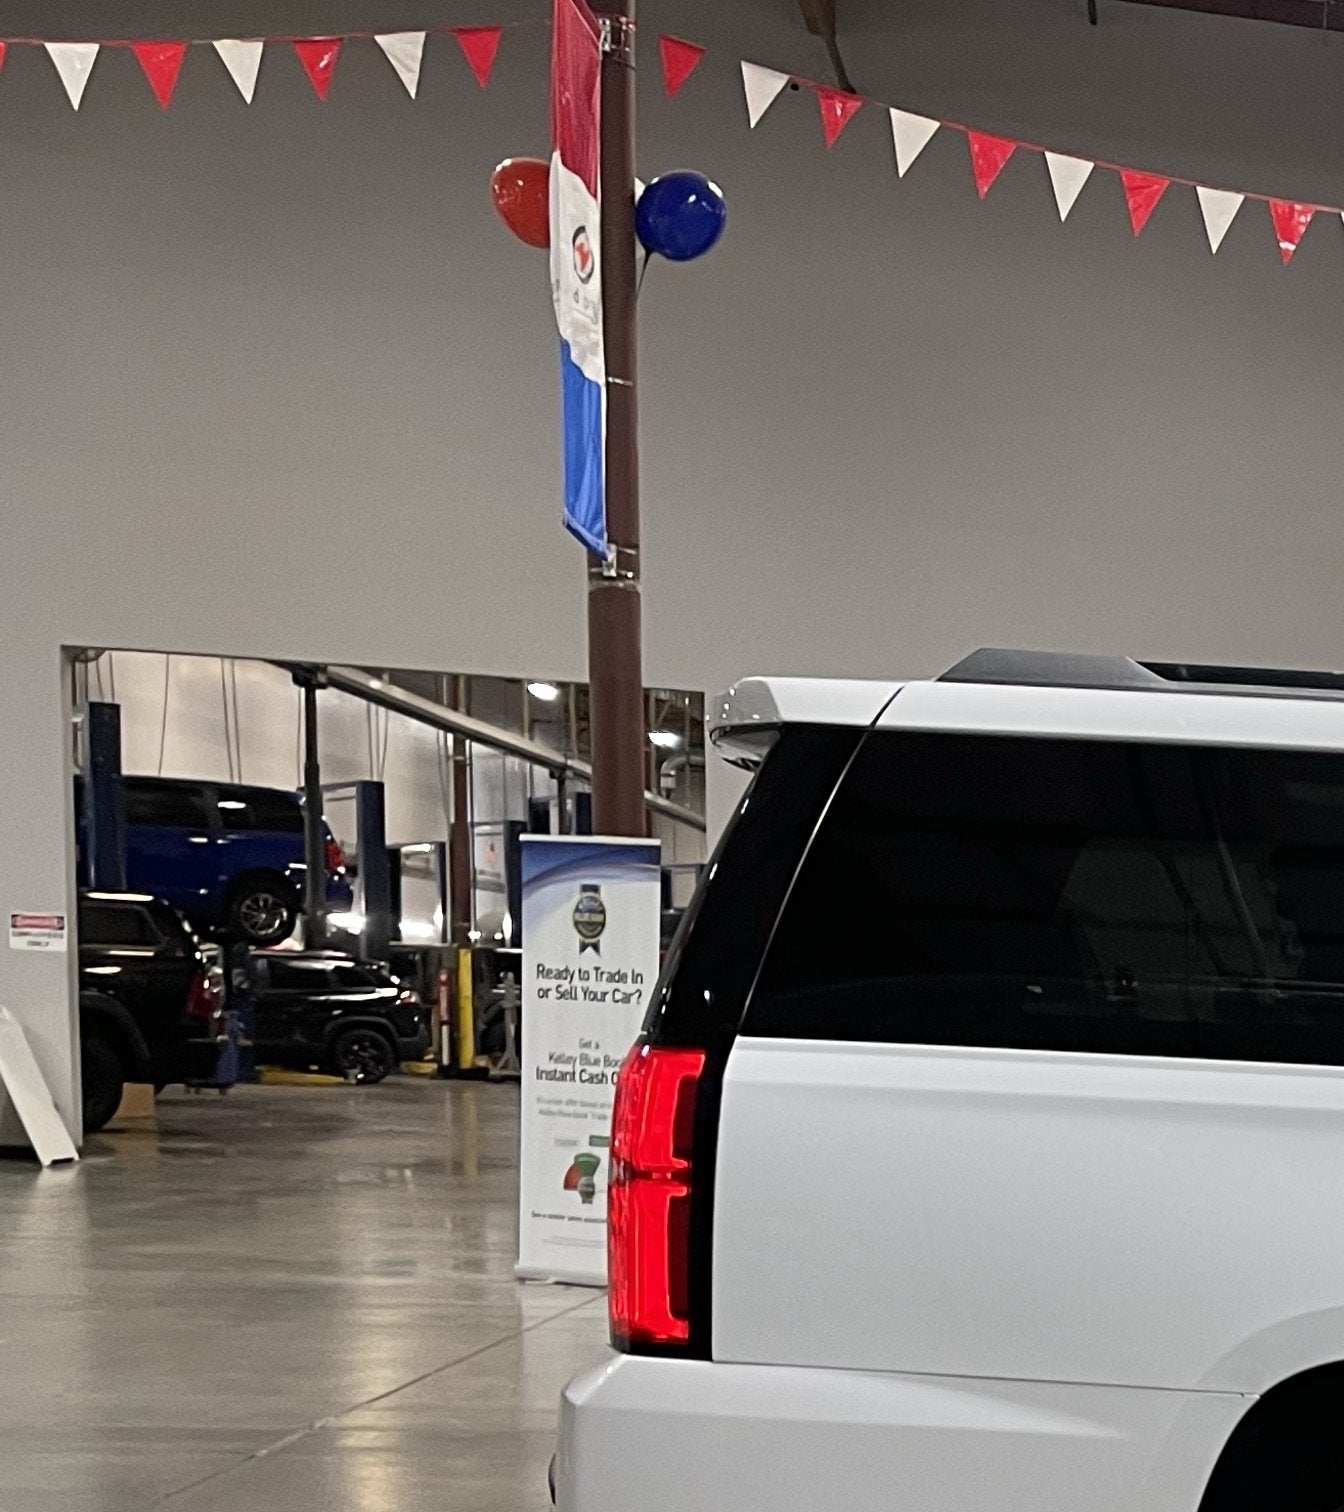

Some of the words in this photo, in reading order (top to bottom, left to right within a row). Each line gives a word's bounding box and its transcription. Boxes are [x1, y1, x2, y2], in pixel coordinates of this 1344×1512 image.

[536, 962, 575, 984] Ready
[578, 967, 590, 982] to
[593, 966, 628, 984] Trade
[631, 968, 644, 985] In
[537, 987, 552, 999] or
[555, 984, 578, 1001] Sell
[581, 986, 609, 1003] Your
[612, 987, 642, 1005] Car?
[548, 1051, 577, 1071] Kelley
[579, 1053, 601, 1068] Blue
[536, 1067, 576, 1083] Instant
[579, 1068, 609, 1086] Cash
